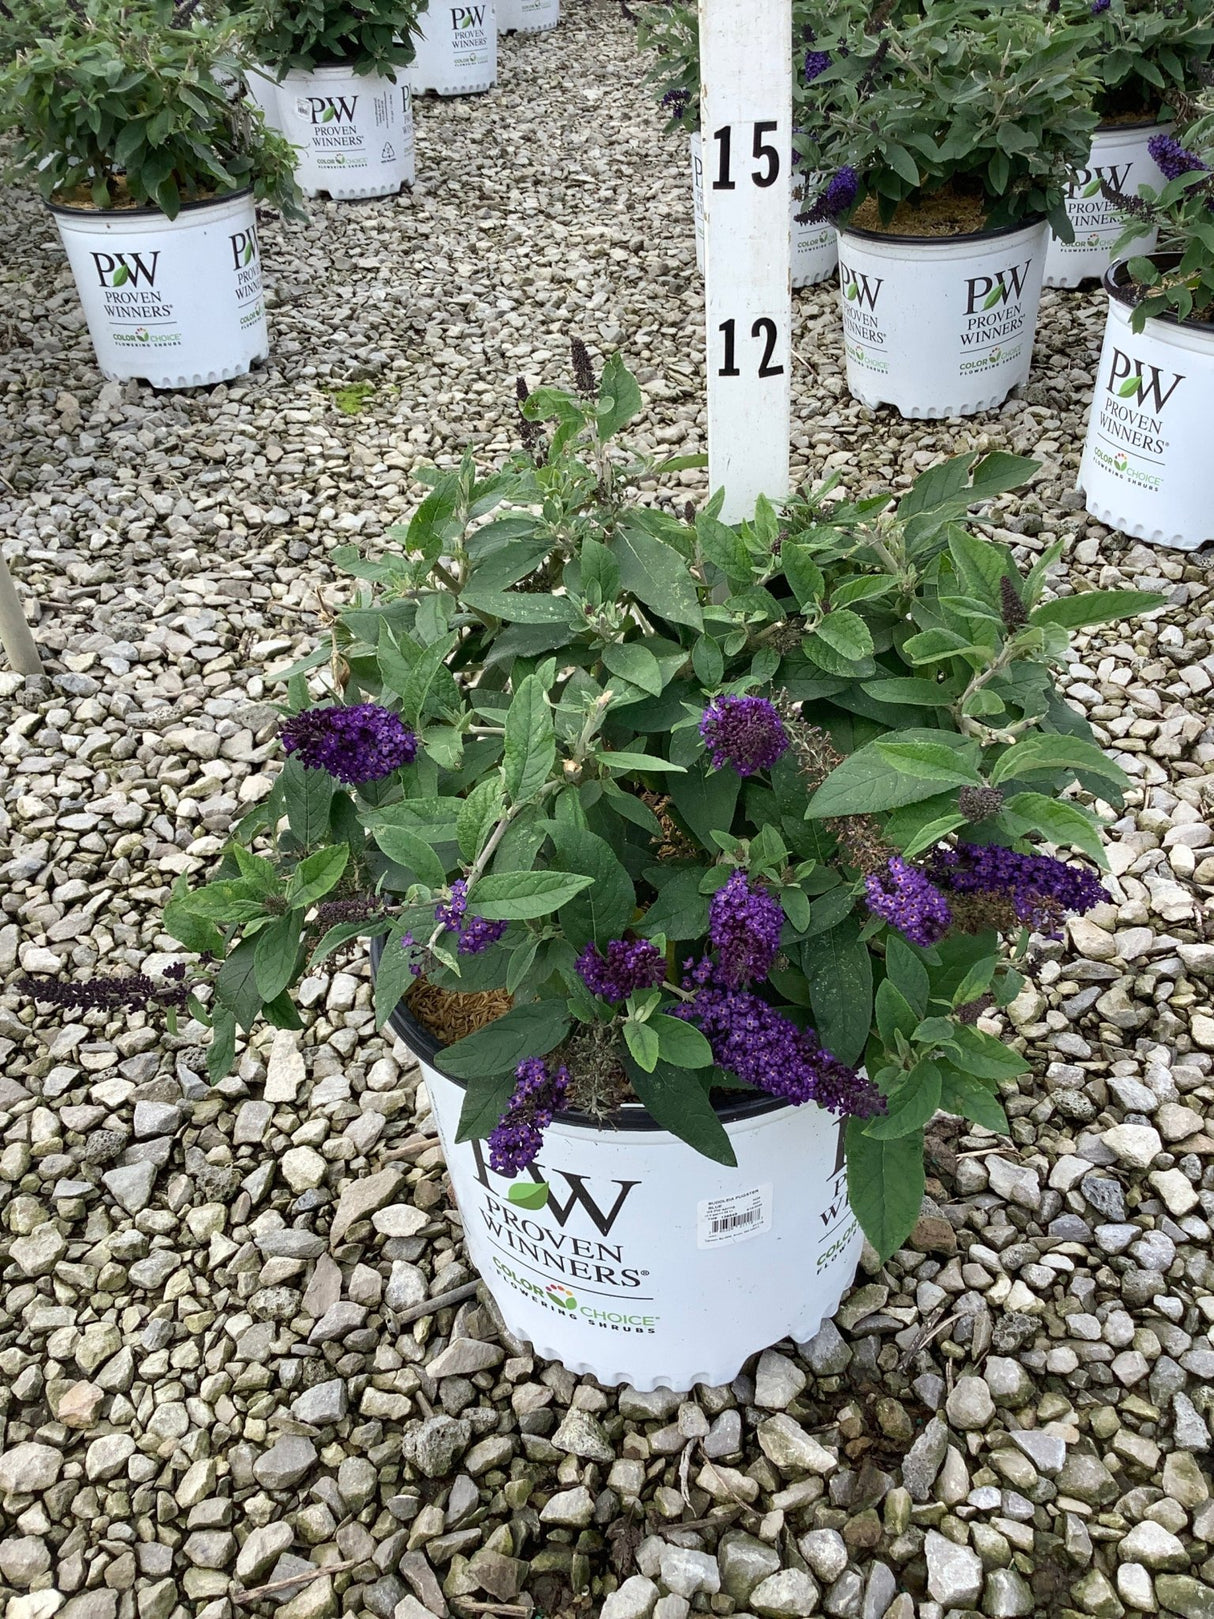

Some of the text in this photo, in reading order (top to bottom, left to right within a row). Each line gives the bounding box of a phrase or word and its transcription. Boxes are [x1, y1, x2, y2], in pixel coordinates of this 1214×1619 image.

[451, 5, 486, 30] PW
[454, 29, 485, 40] PROVEN
[306, 95, 359, 124] PW
[314, 125, 357, 136] PROVEN
[713, 121, 780, 190] 15
[1068, 201, 1117, 213] PROVE
[1071, 214, 1123, 226] INNER
[797, 239, 819, 248] COLOR
[89, 251, 161, 288] PW
[104, 290, 162, 303] PROVEN
[840, 260, 885, 312] PW
[962, 258, 1032, 316] PW
[968, 302, 1022, 331] PROVEN
[113, 333, 136, 342] COLOR
[718, 317, 784, 378] 12
[960, 358, 988, 370] COLOR
[1106, 347, 1187, 414] PW
[1105, 397, 1164, 435] PROVEN
[1094, 446, 1113, 466] COLOR
[484, 1193, 624, 1263] PROVEN
[492, 1256, 545, 1297] COLOR
[496, 1269, 656, 1334] FLOWERING SHRUBS
